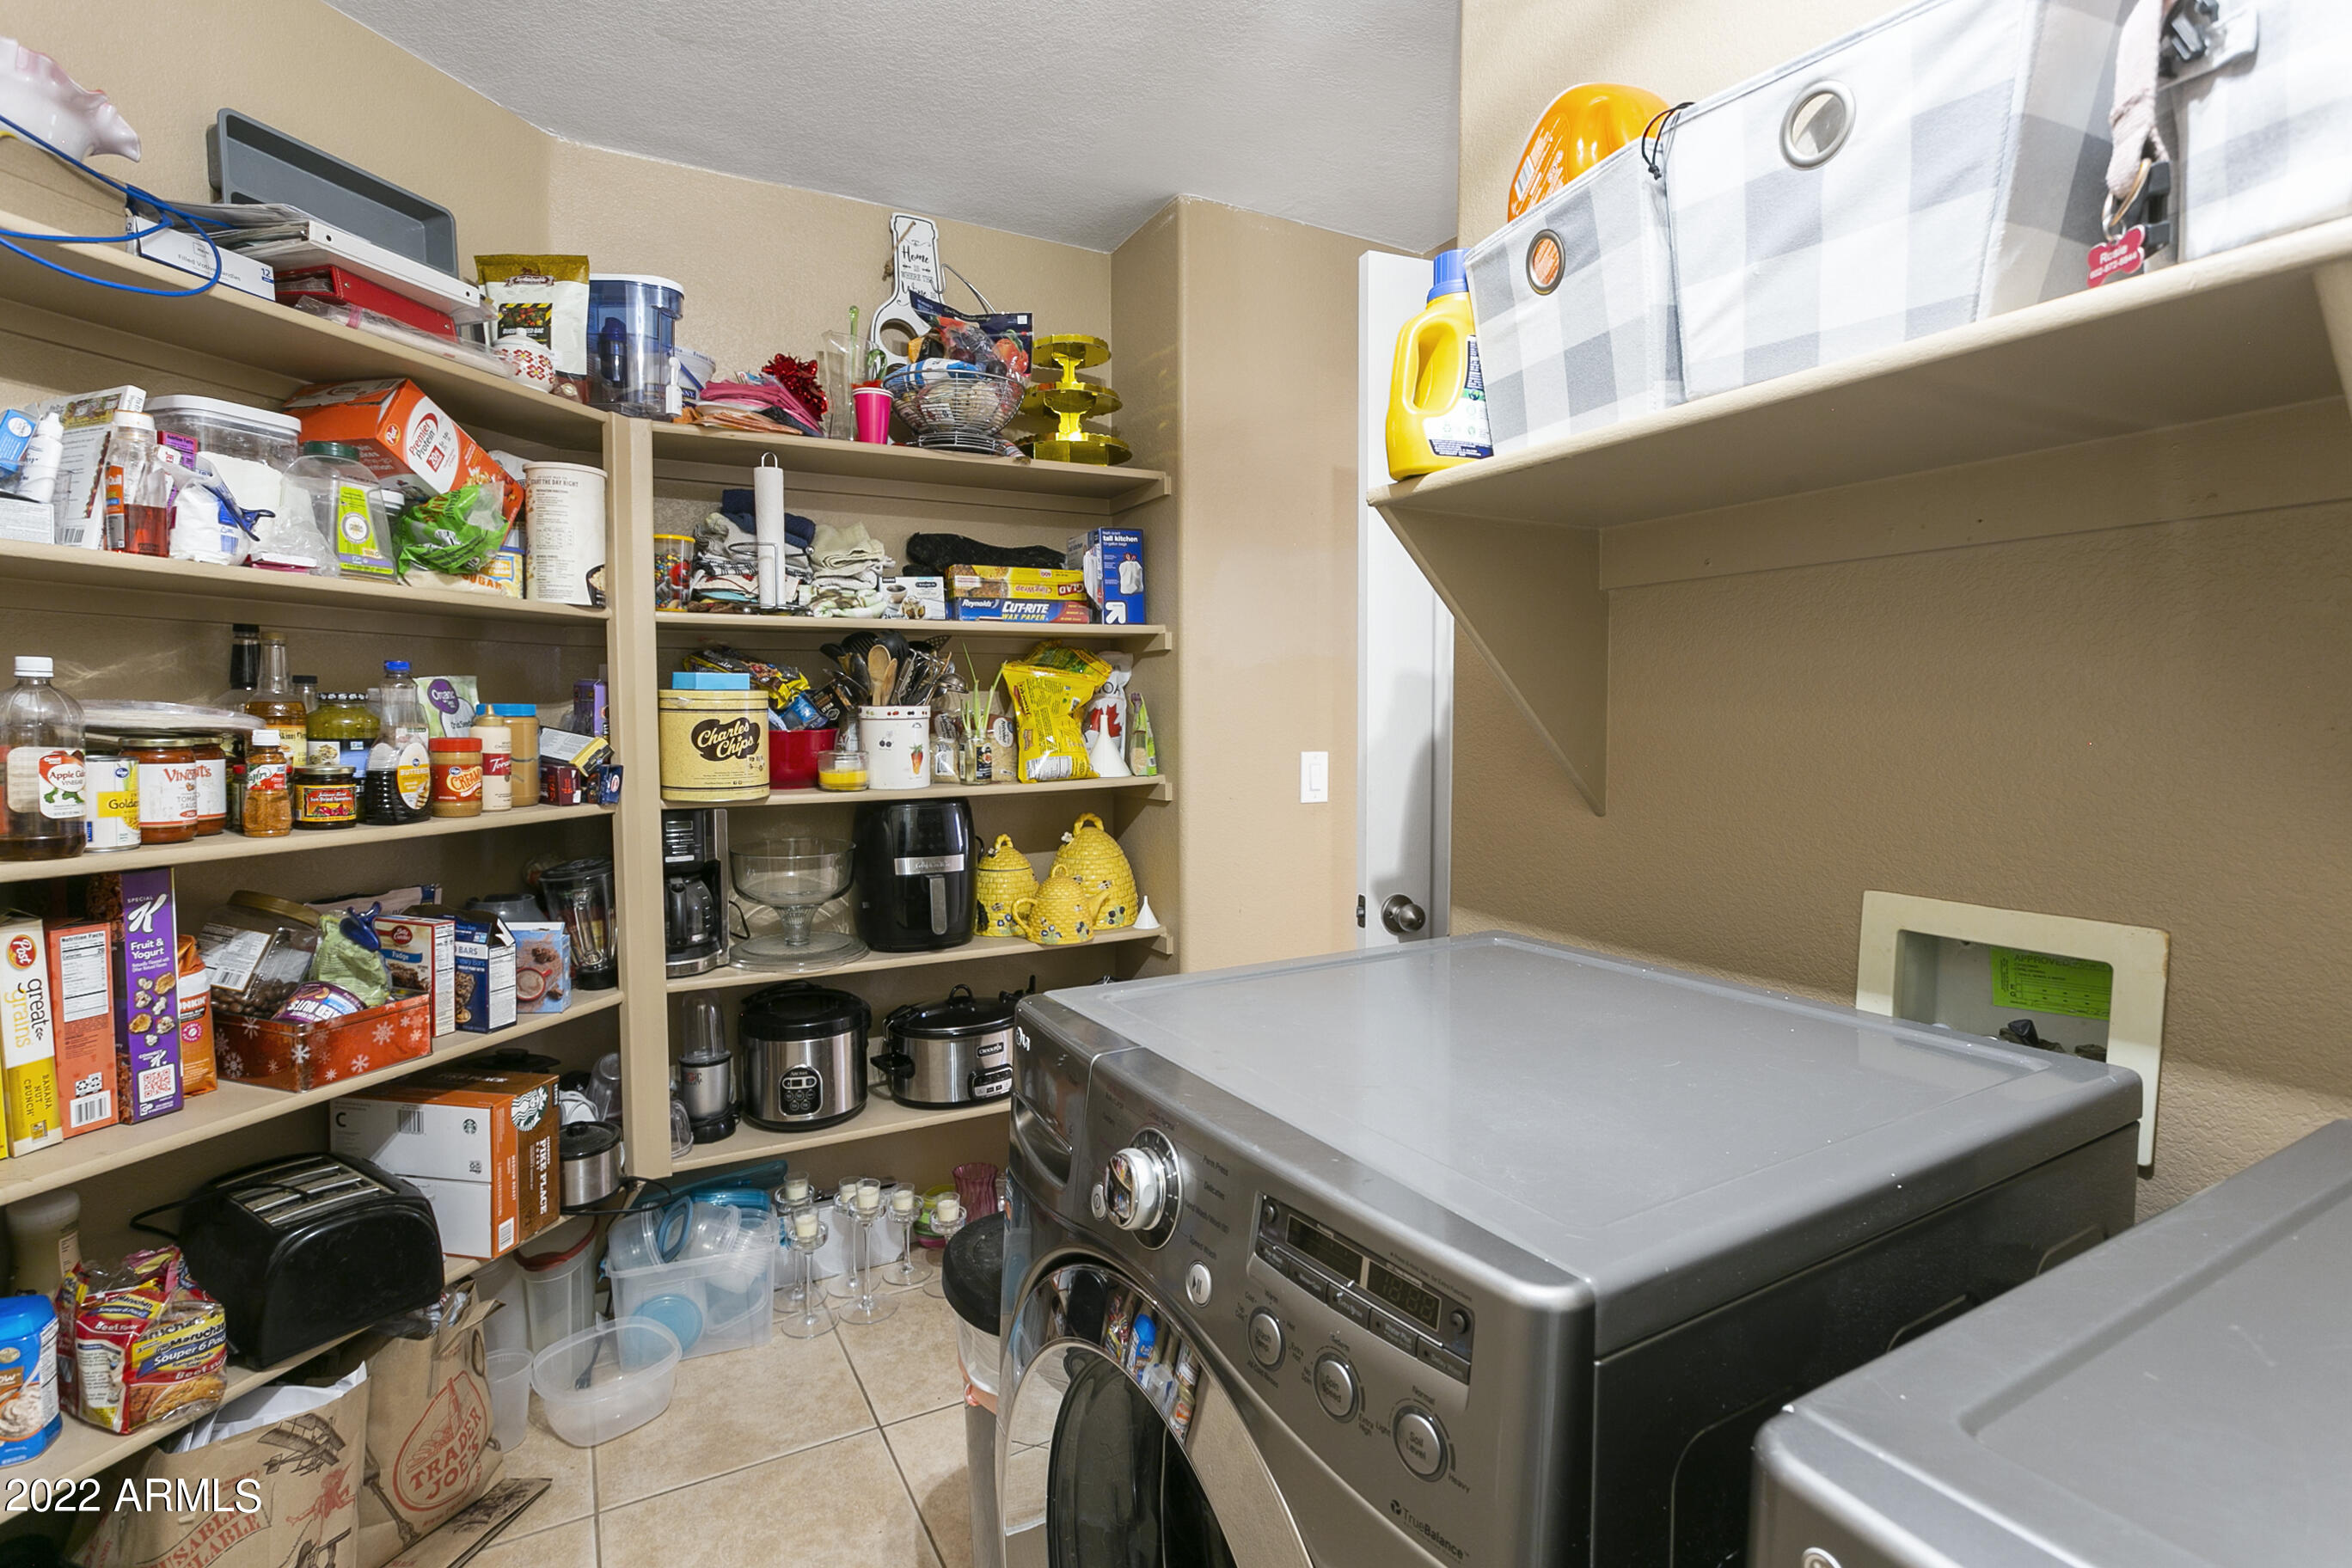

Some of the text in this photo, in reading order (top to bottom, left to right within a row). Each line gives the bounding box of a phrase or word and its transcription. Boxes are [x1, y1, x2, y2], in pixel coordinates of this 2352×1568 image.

[902, 245, 930, 264] Home
[408, 421, 432, 456] Premier
[416, 430, 436, 460] Protein
[1058, 584, 1083, 596] GLAD
[962, 599, 992, 609] Reynolds
[1001, 601, 1050, 614] CUT-RITE
[697, 720, 750, 749] Charles
[715, 734, 755, 759] Chips
[49, 771, 76, 781] Apple
[126, 895, 154, 903] SPECIAL
[127, 893, 168, 933] K
[61, 934, 87, 943] Nutrition
[130, 937, 164, 951] Fruit &
[12, 937, 33, 965] Post
[132, 947, 165, 960] Yogurt
[391, 950, 410, 961] Fudge
[458, 946, 479, 955] BARS
[2014, 954, 2073, 967] APPROVED
[28, 977, 50, 1032] great
[286, 999, 315, 1014] NUTS
[5, 989, 32, 1049] grains
[43, 1074, 52, 1110] BANANA
[335, 1112, 347, 1128] C
[540, 1171, 548, 1216] PLACE
[117, 1295, 154, 1310] Maruchan
[95, 1320, 119, 1331] Beef
[154, 1345, 196, 1366] Souper
[198, 1341, 206, 1351] 6
[175, 1364, 208, 1381] Beef
[1412, 1385, 1436, 1406] Normal
[408, 1406, 482, 1492] TRADER
[1409, 1430, 1424, 1449] Soil
[1406, 1440, 1427, 1461] Level
[425, 1436, 481, 1501] JOE'S
[1448, 1472, 1471, 1495] Heavy
